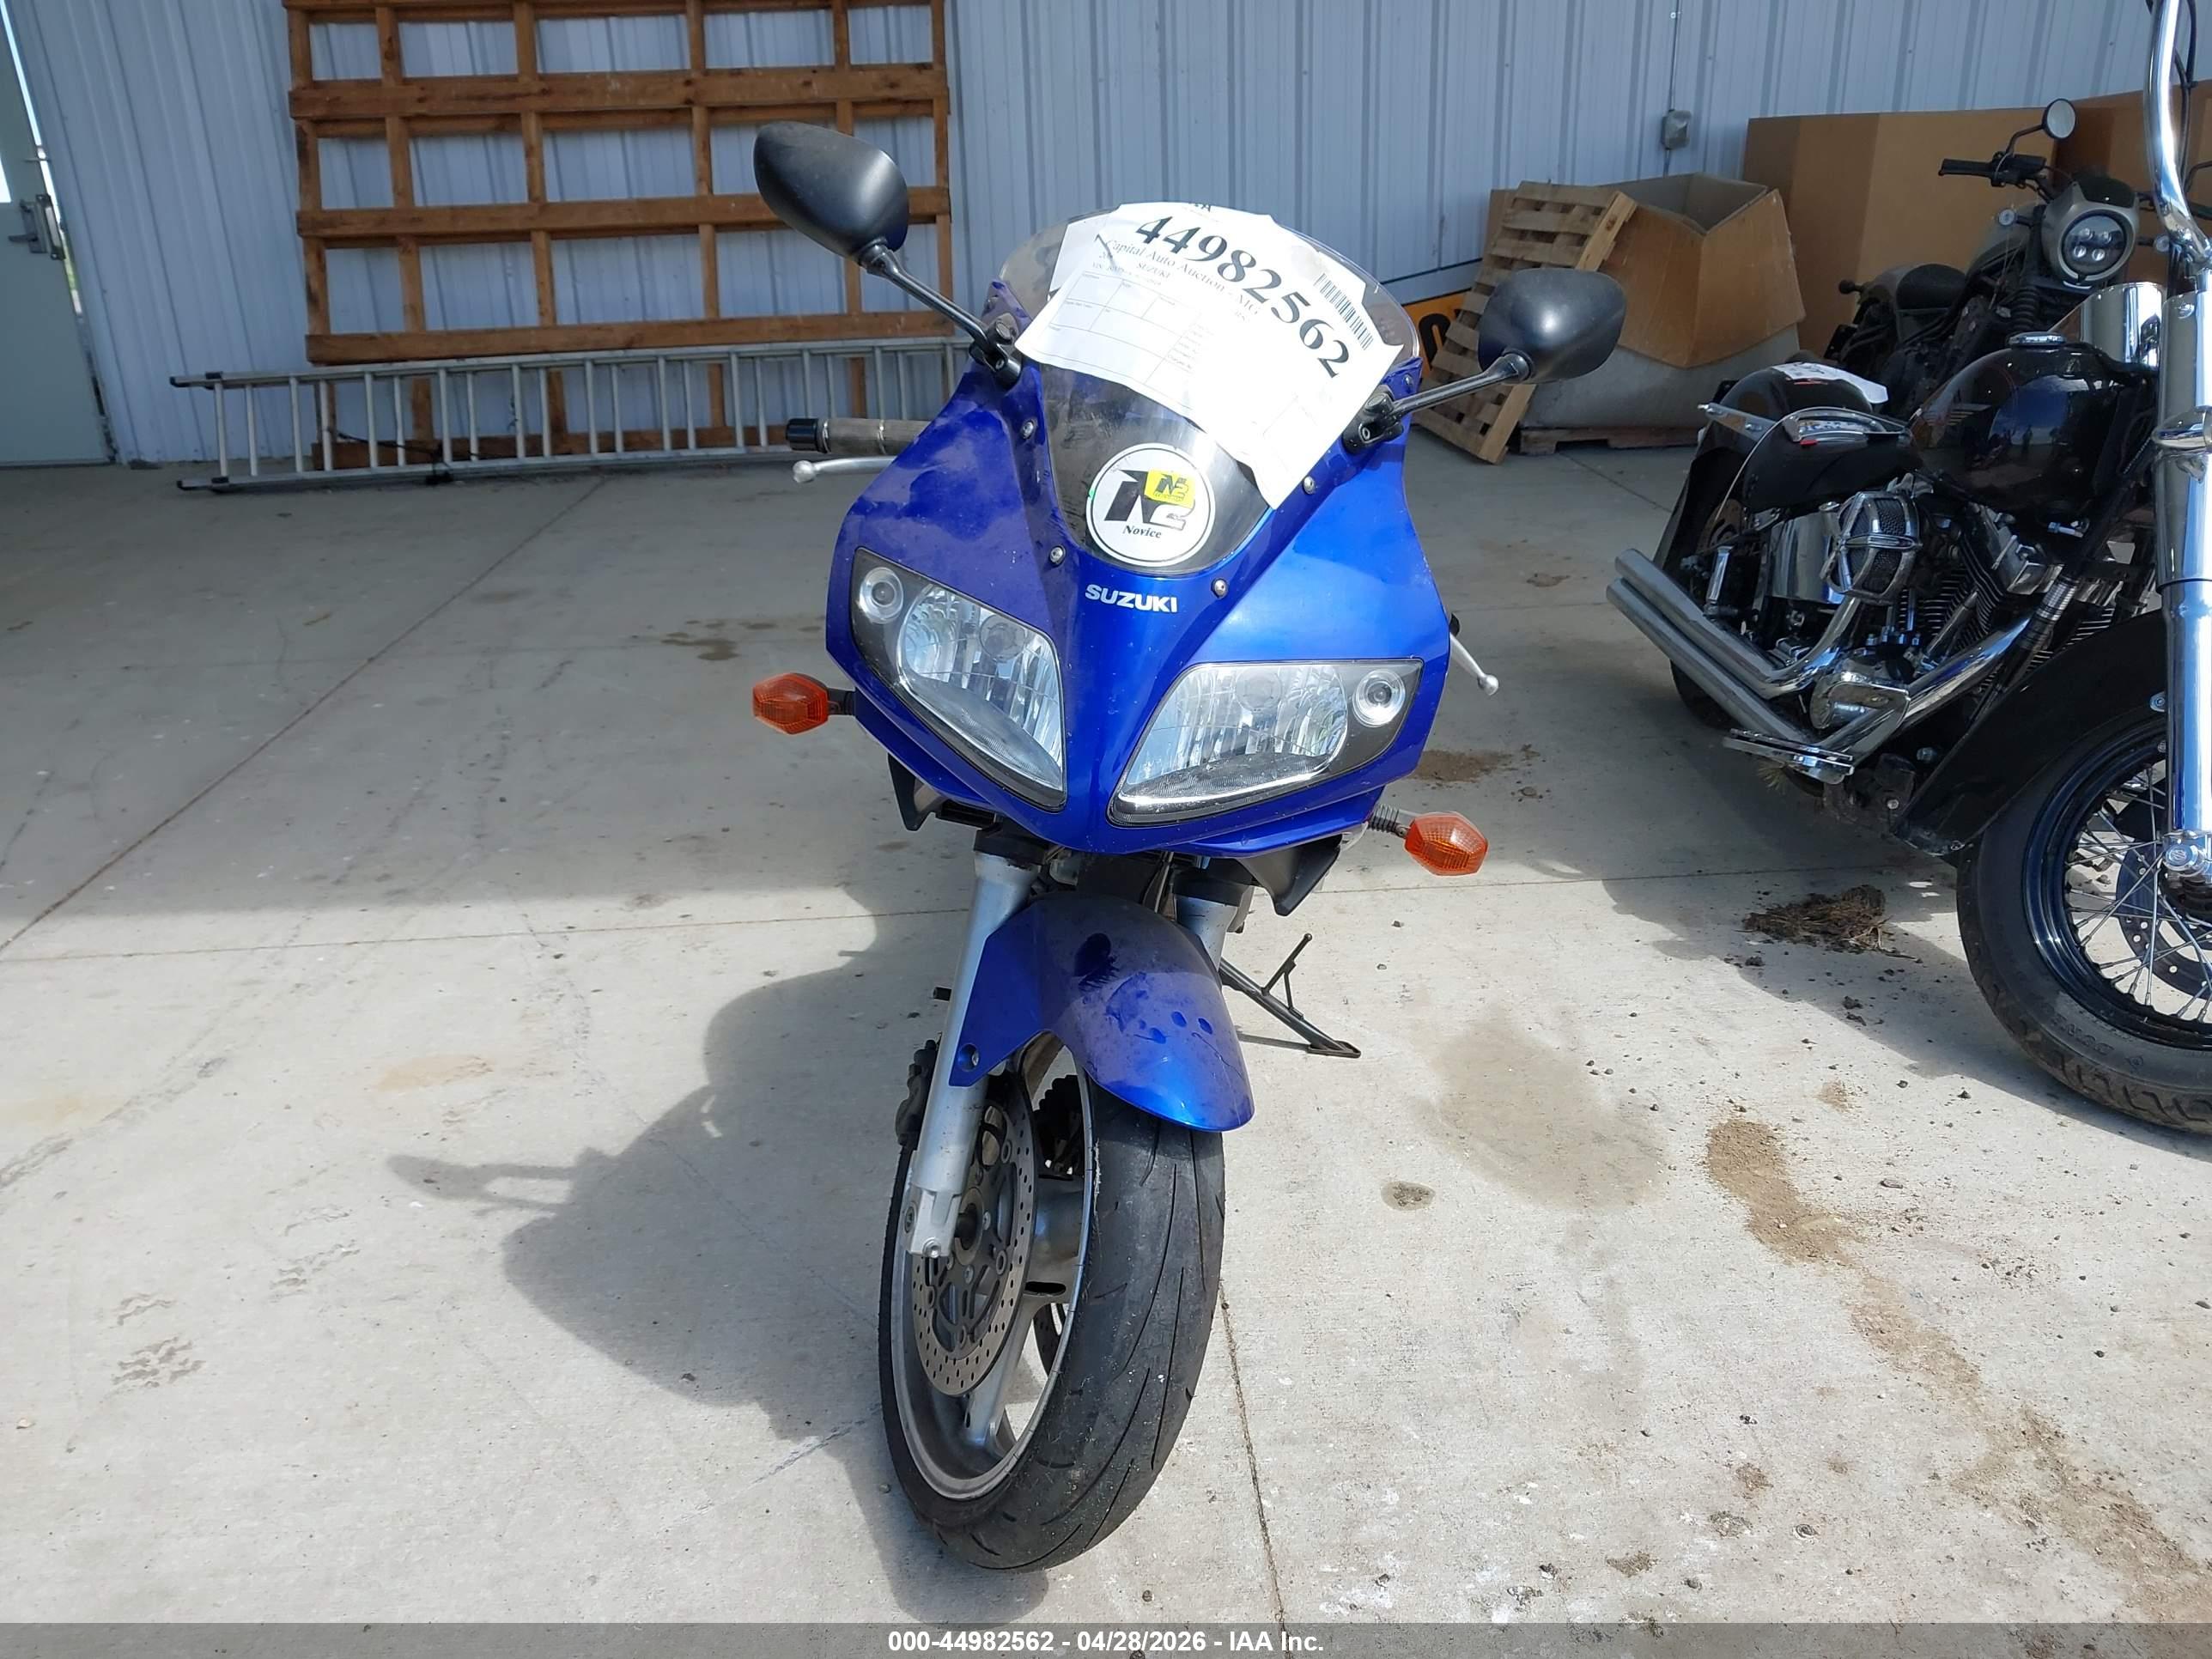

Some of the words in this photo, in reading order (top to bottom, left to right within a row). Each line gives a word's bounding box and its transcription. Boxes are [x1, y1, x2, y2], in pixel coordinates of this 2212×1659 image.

[1106, 240, 1146, 257] Capital
[1146, 251, 1176, 267] Auto
[1177, 263, 1226, 294] Auction
[1136, 262, 1171, 279] SUZUKI
[1135, 216, 1350, 379] 44982562
[1122, 524, 1162, 539] Novice
[1085, 583, 1178, 613] SUZUKI
